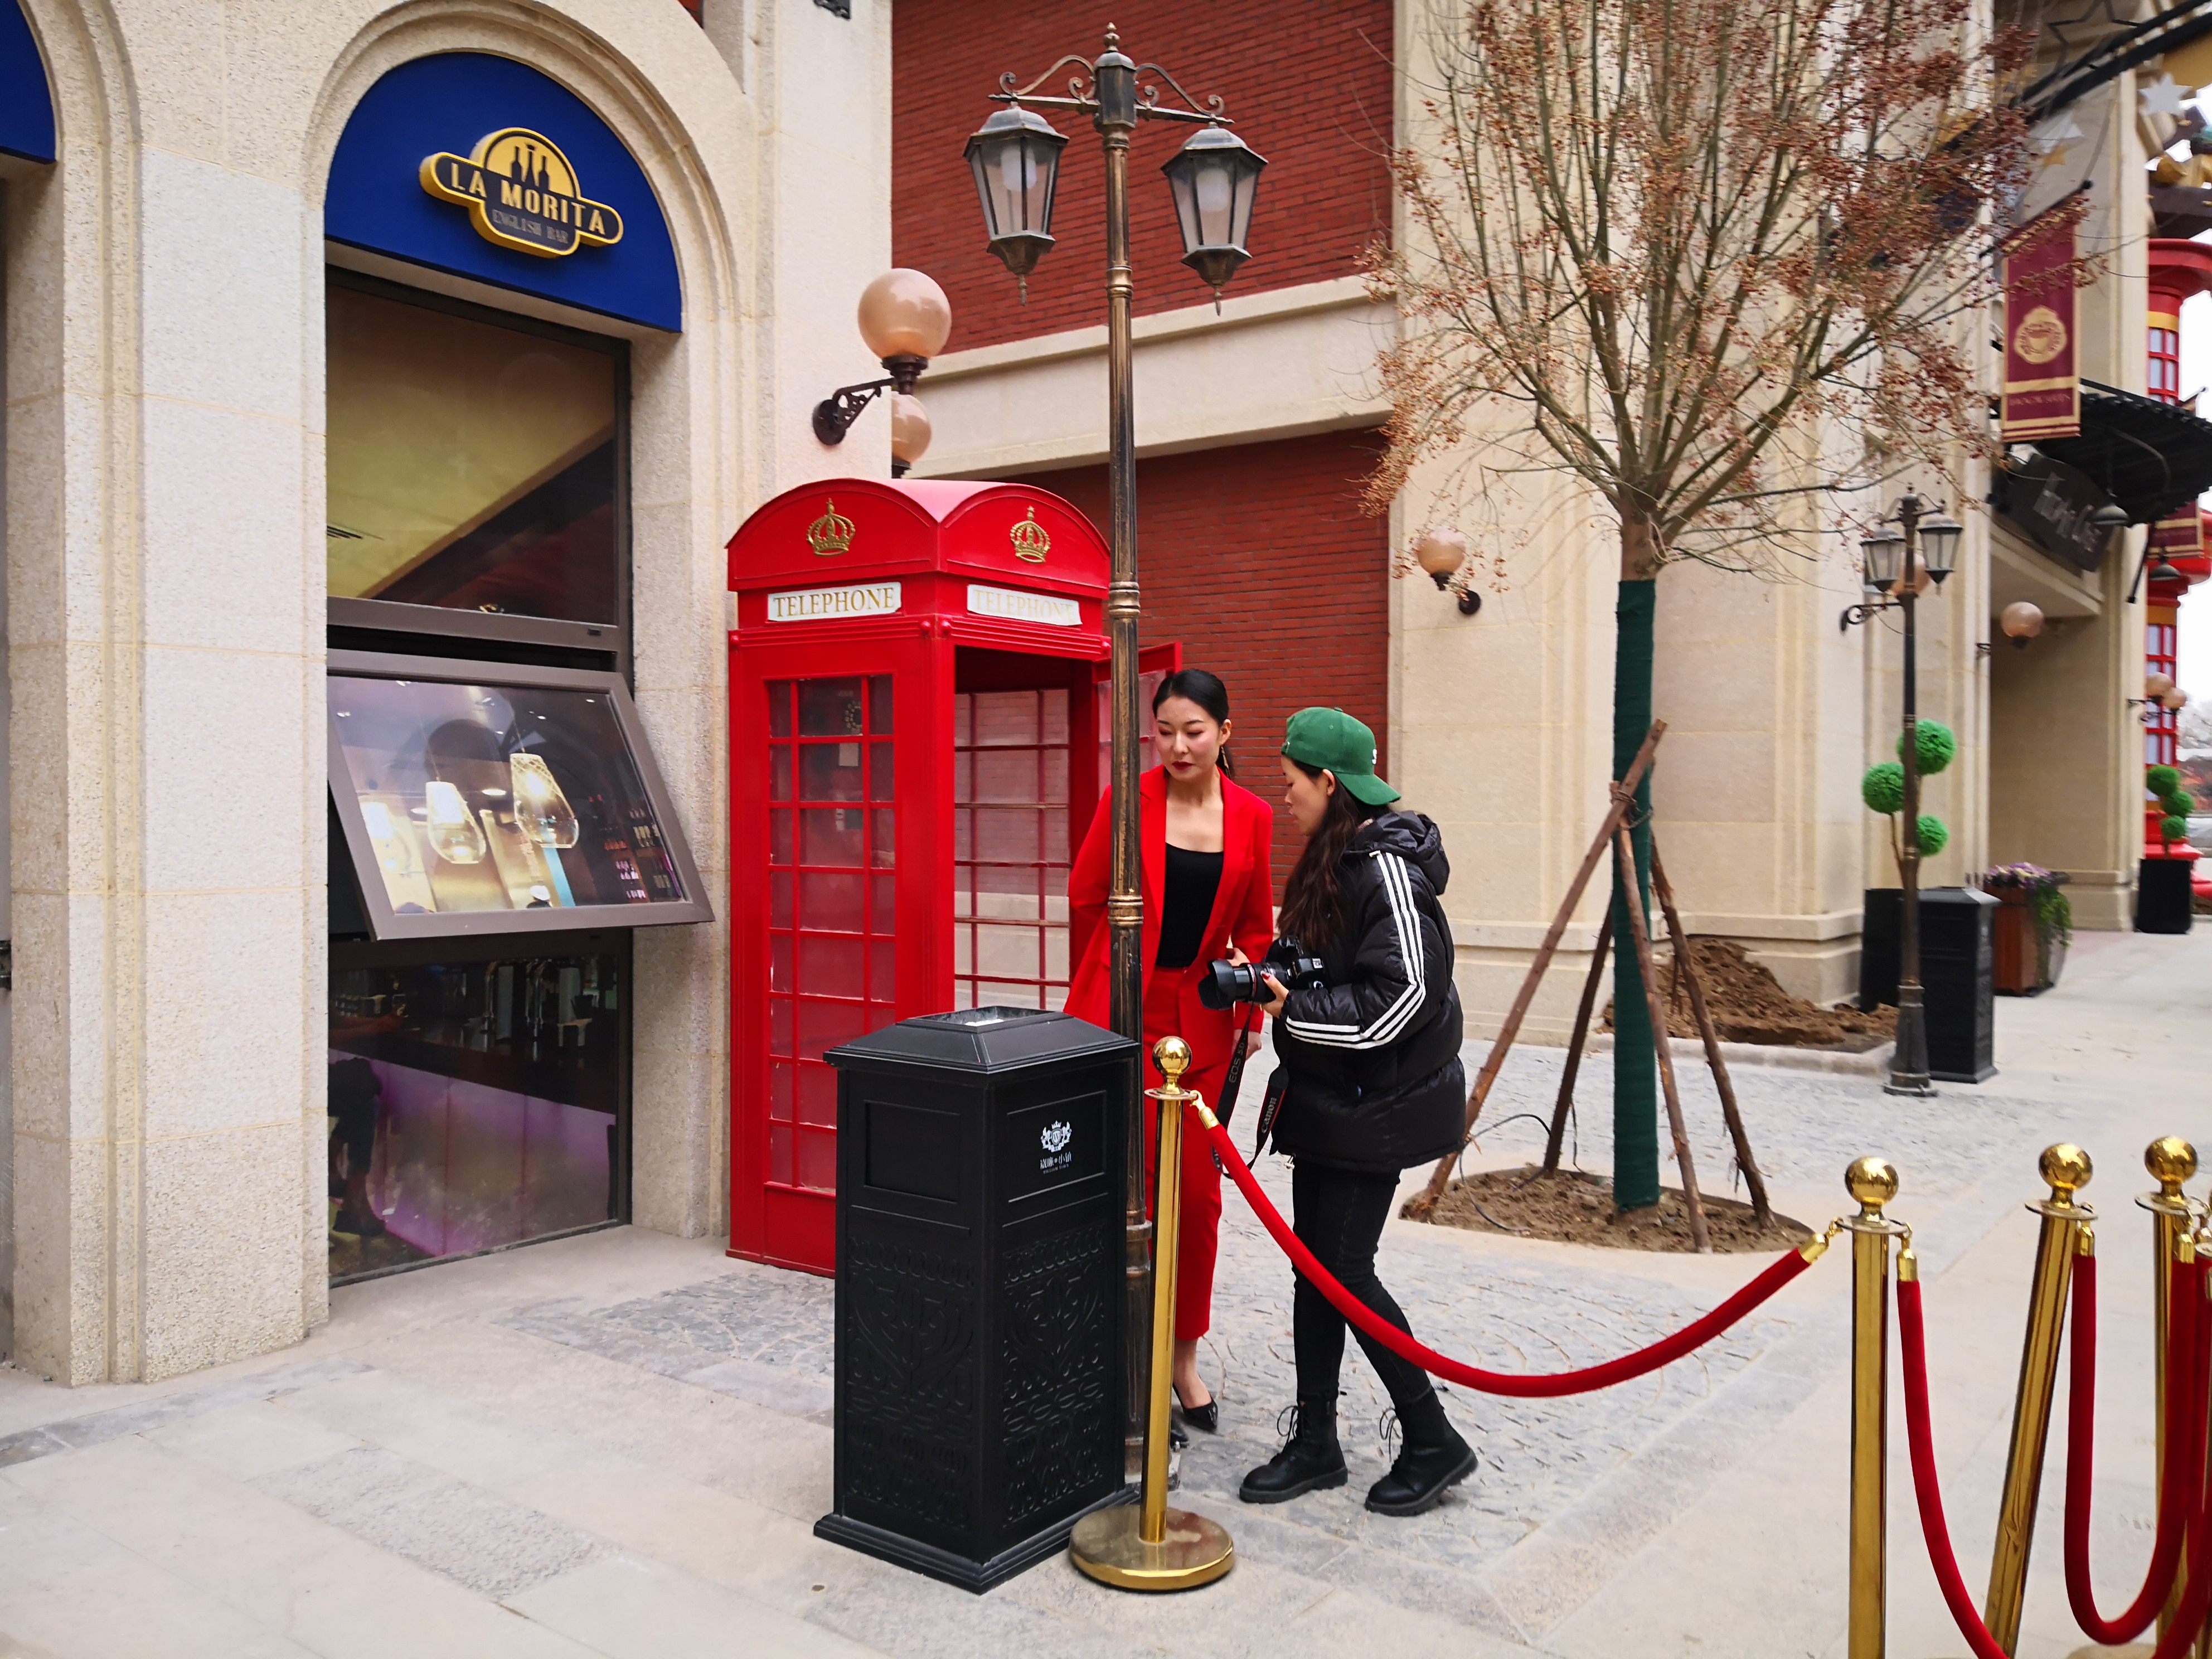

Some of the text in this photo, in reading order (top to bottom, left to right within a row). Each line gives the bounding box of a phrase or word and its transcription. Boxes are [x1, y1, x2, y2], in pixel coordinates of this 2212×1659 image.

[450, 162, 606, 235] LA MORITA
[773, 586, 894, 618] TELEPHONE
[973, 589, 1074, 623] TELEPHONE
[1229, 1058, 1241, 1083] EOS
[1261, 1097, 1277, 1134] Canon
